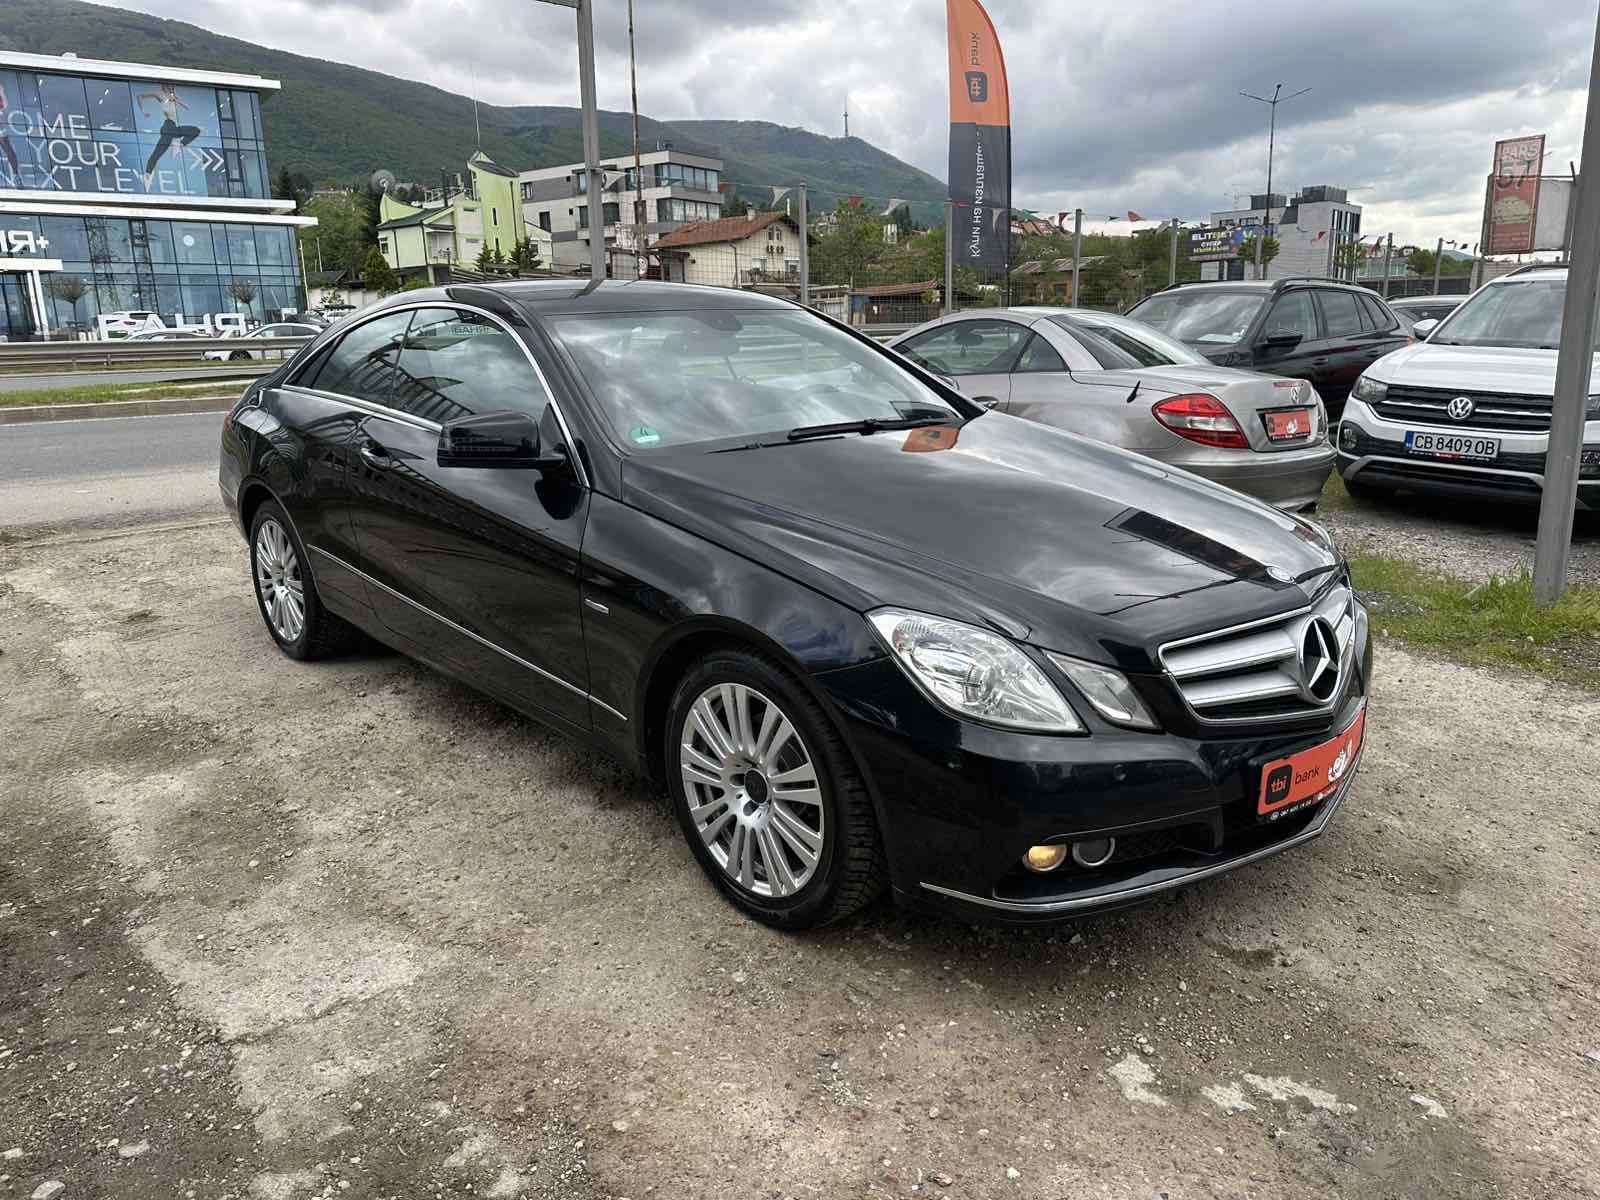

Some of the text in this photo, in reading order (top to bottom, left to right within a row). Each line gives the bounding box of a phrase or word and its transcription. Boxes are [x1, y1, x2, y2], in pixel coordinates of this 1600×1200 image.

[0, 110, 89, 138] OME
[26, 138, 122, 167] YOUR
[95, 167, 197, 194] LEVEL
[1414, 434, 1434, 450] CB
[1435, 436, 1473, 454] 8409
[1270, 765, 1320, 793] tbi bank
